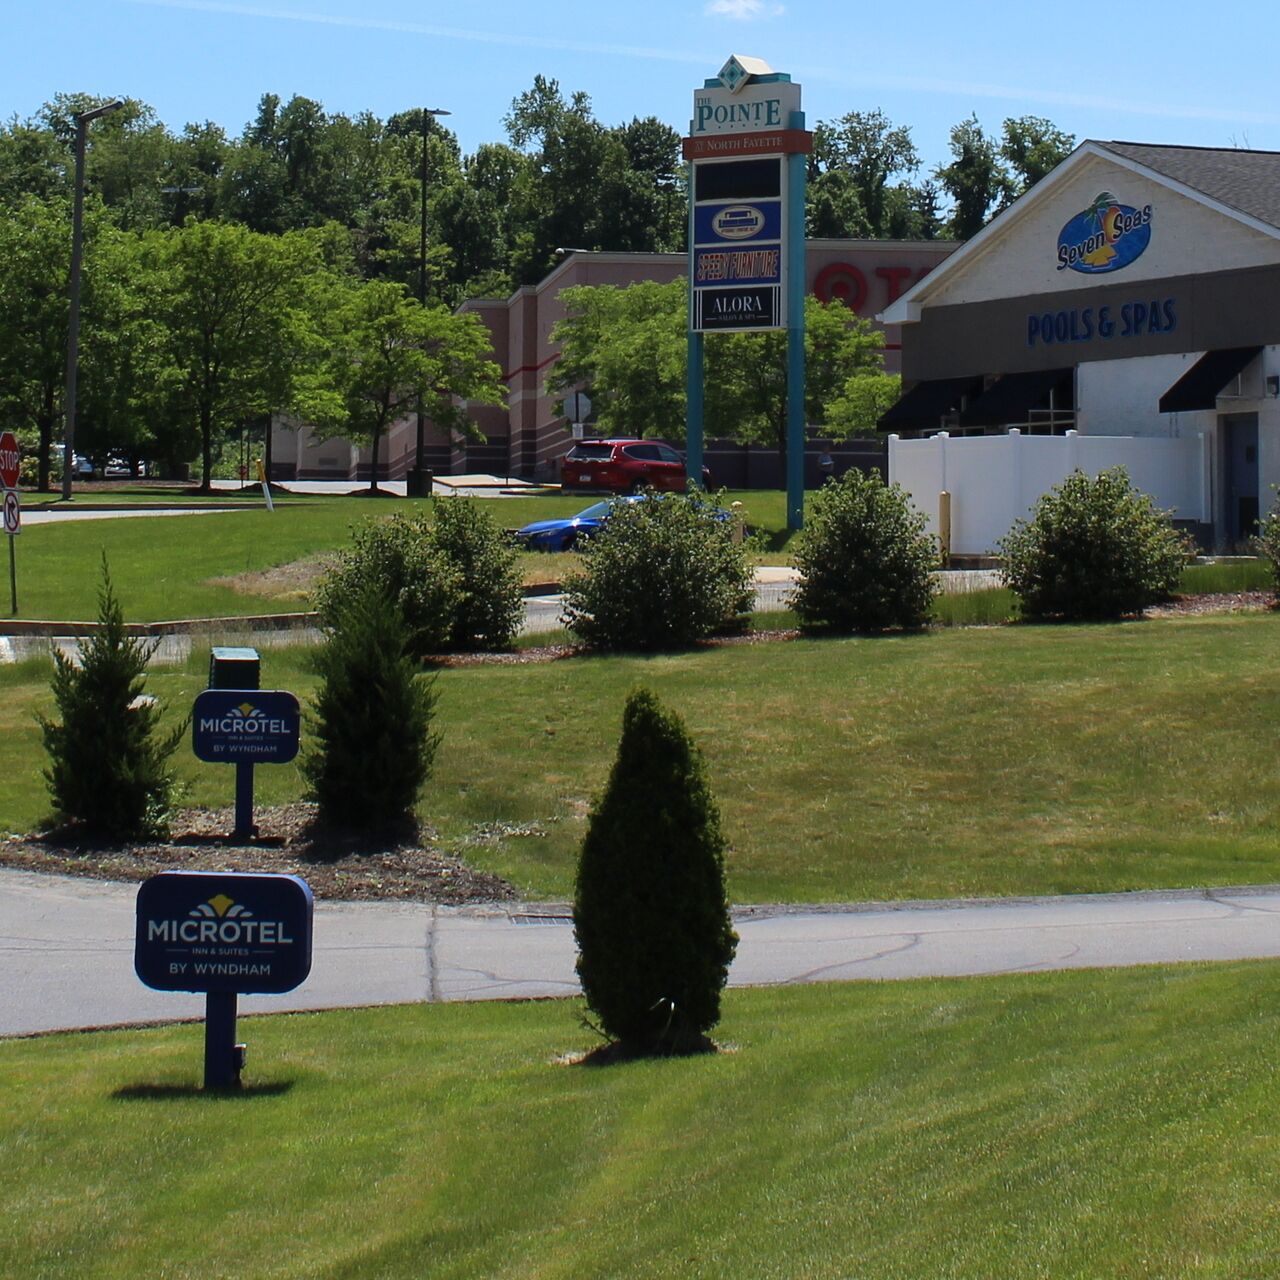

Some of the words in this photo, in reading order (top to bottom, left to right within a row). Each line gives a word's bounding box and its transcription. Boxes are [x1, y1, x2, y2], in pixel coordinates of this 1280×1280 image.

[697, 97, 712, 105] THE
[696, 99, 781, 131] POINTE
[695, 141, 704, 152] AT
[707, 140, 740, 151] NORTH
[743, 136, 784, 148] FAYETTE
[1057, 231, 1105, 270] Seven
[1113, 204, 1152, 239] Seas
[697, 252, 730, 281] SPEEDY
[729, 250, 779, 279] FURNITURE
[713, 296, 762, 313] ALORA
[1026, 306, 1094, 347] POOLS
[1098, 305, 1114, 338] &
[1120, 298, 1177, 336] SPAS
[0, 449, 18, 471] STOP
[200, 718, 291, 733] MICROTEL
[213, 745, 225, 753] BY
[229, 745, 277, 753] WYNDHAM
[148, 920, 293, 943] MICROTEL
[218, 948, 249, 956] SUITES
[170, 963, 187, 974] BY
[194, 963, 271, 975] WYNDHAM
